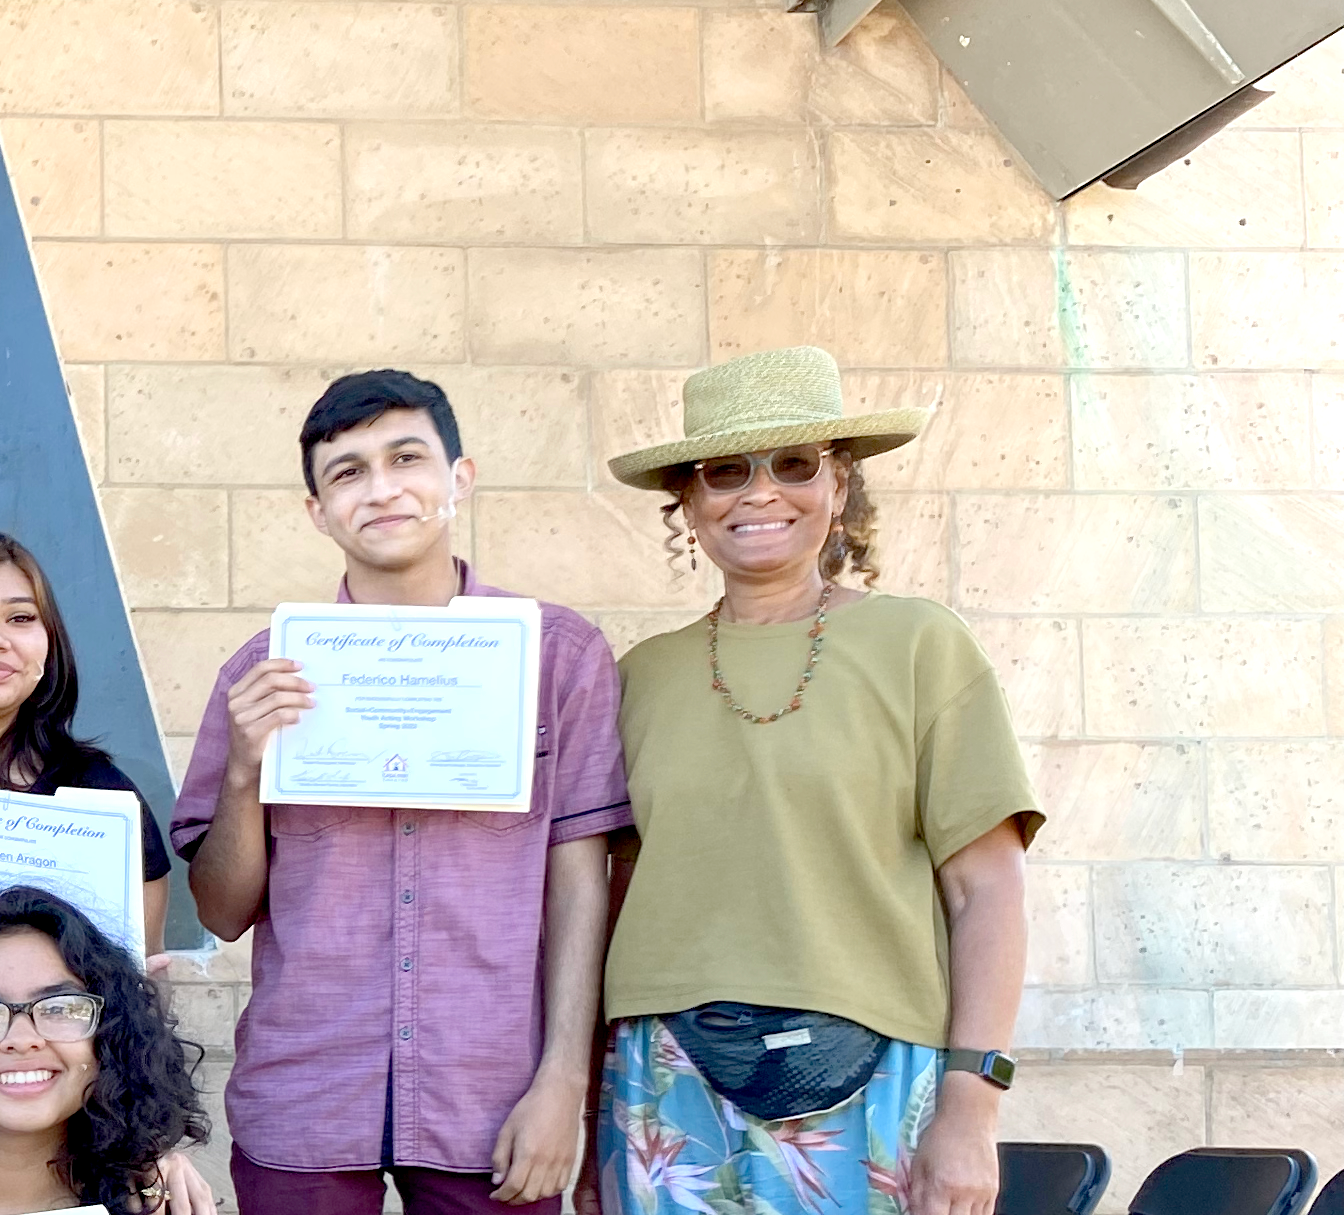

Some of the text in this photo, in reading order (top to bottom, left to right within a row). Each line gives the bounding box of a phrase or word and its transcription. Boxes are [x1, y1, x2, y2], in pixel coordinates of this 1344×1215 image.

[305, 632, 500, 652] Certificate of Completion
[342, 673, 397, 685] Federico
[4, 816, 27, 831] of
[25, 817, 107, 838] Completion
[16, 853, 57, 868] Aragon
